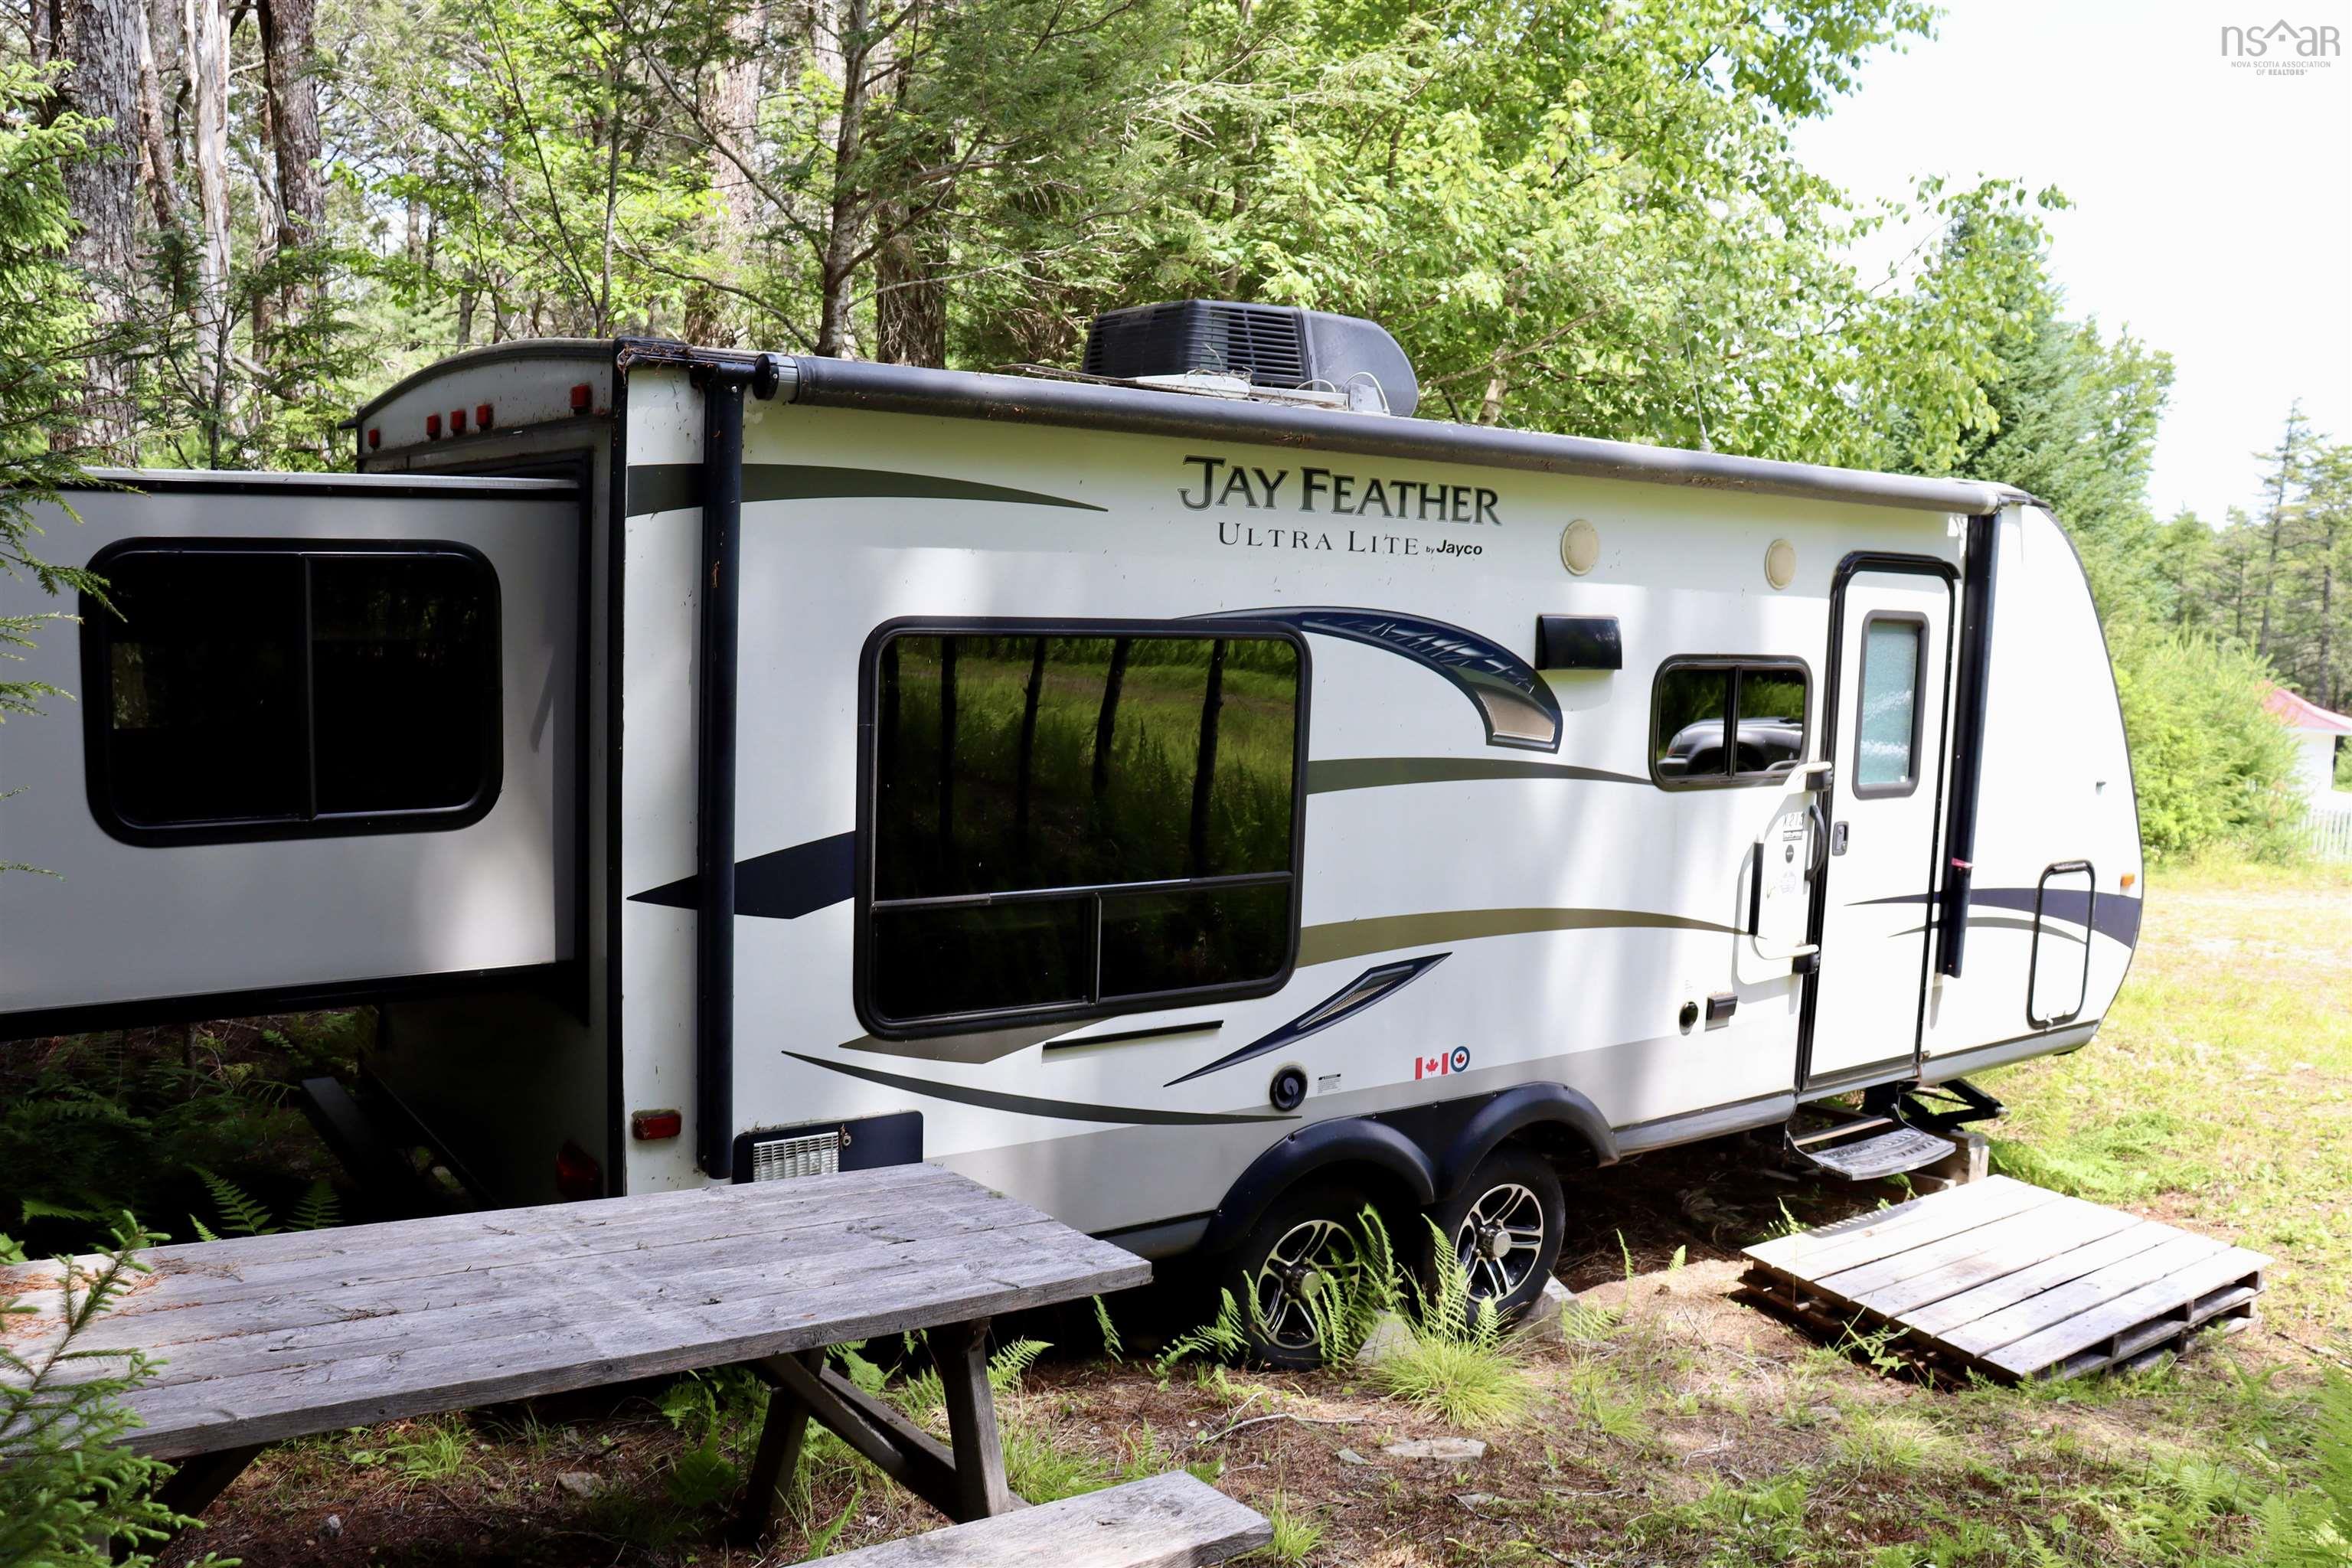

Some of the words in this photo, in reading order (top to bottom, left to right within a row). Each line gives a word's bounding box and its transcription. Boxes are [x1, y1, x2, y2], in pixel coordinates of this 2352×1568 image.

[1178, 455, 1289, 511] JAY
[1298, 466, 1502, 527] FEATHER
[1218, 521, 1333, 550] ULTRA
[1348, 530, 1419, 555] LITE
[1436, 539, 1483, 557] Jayco
